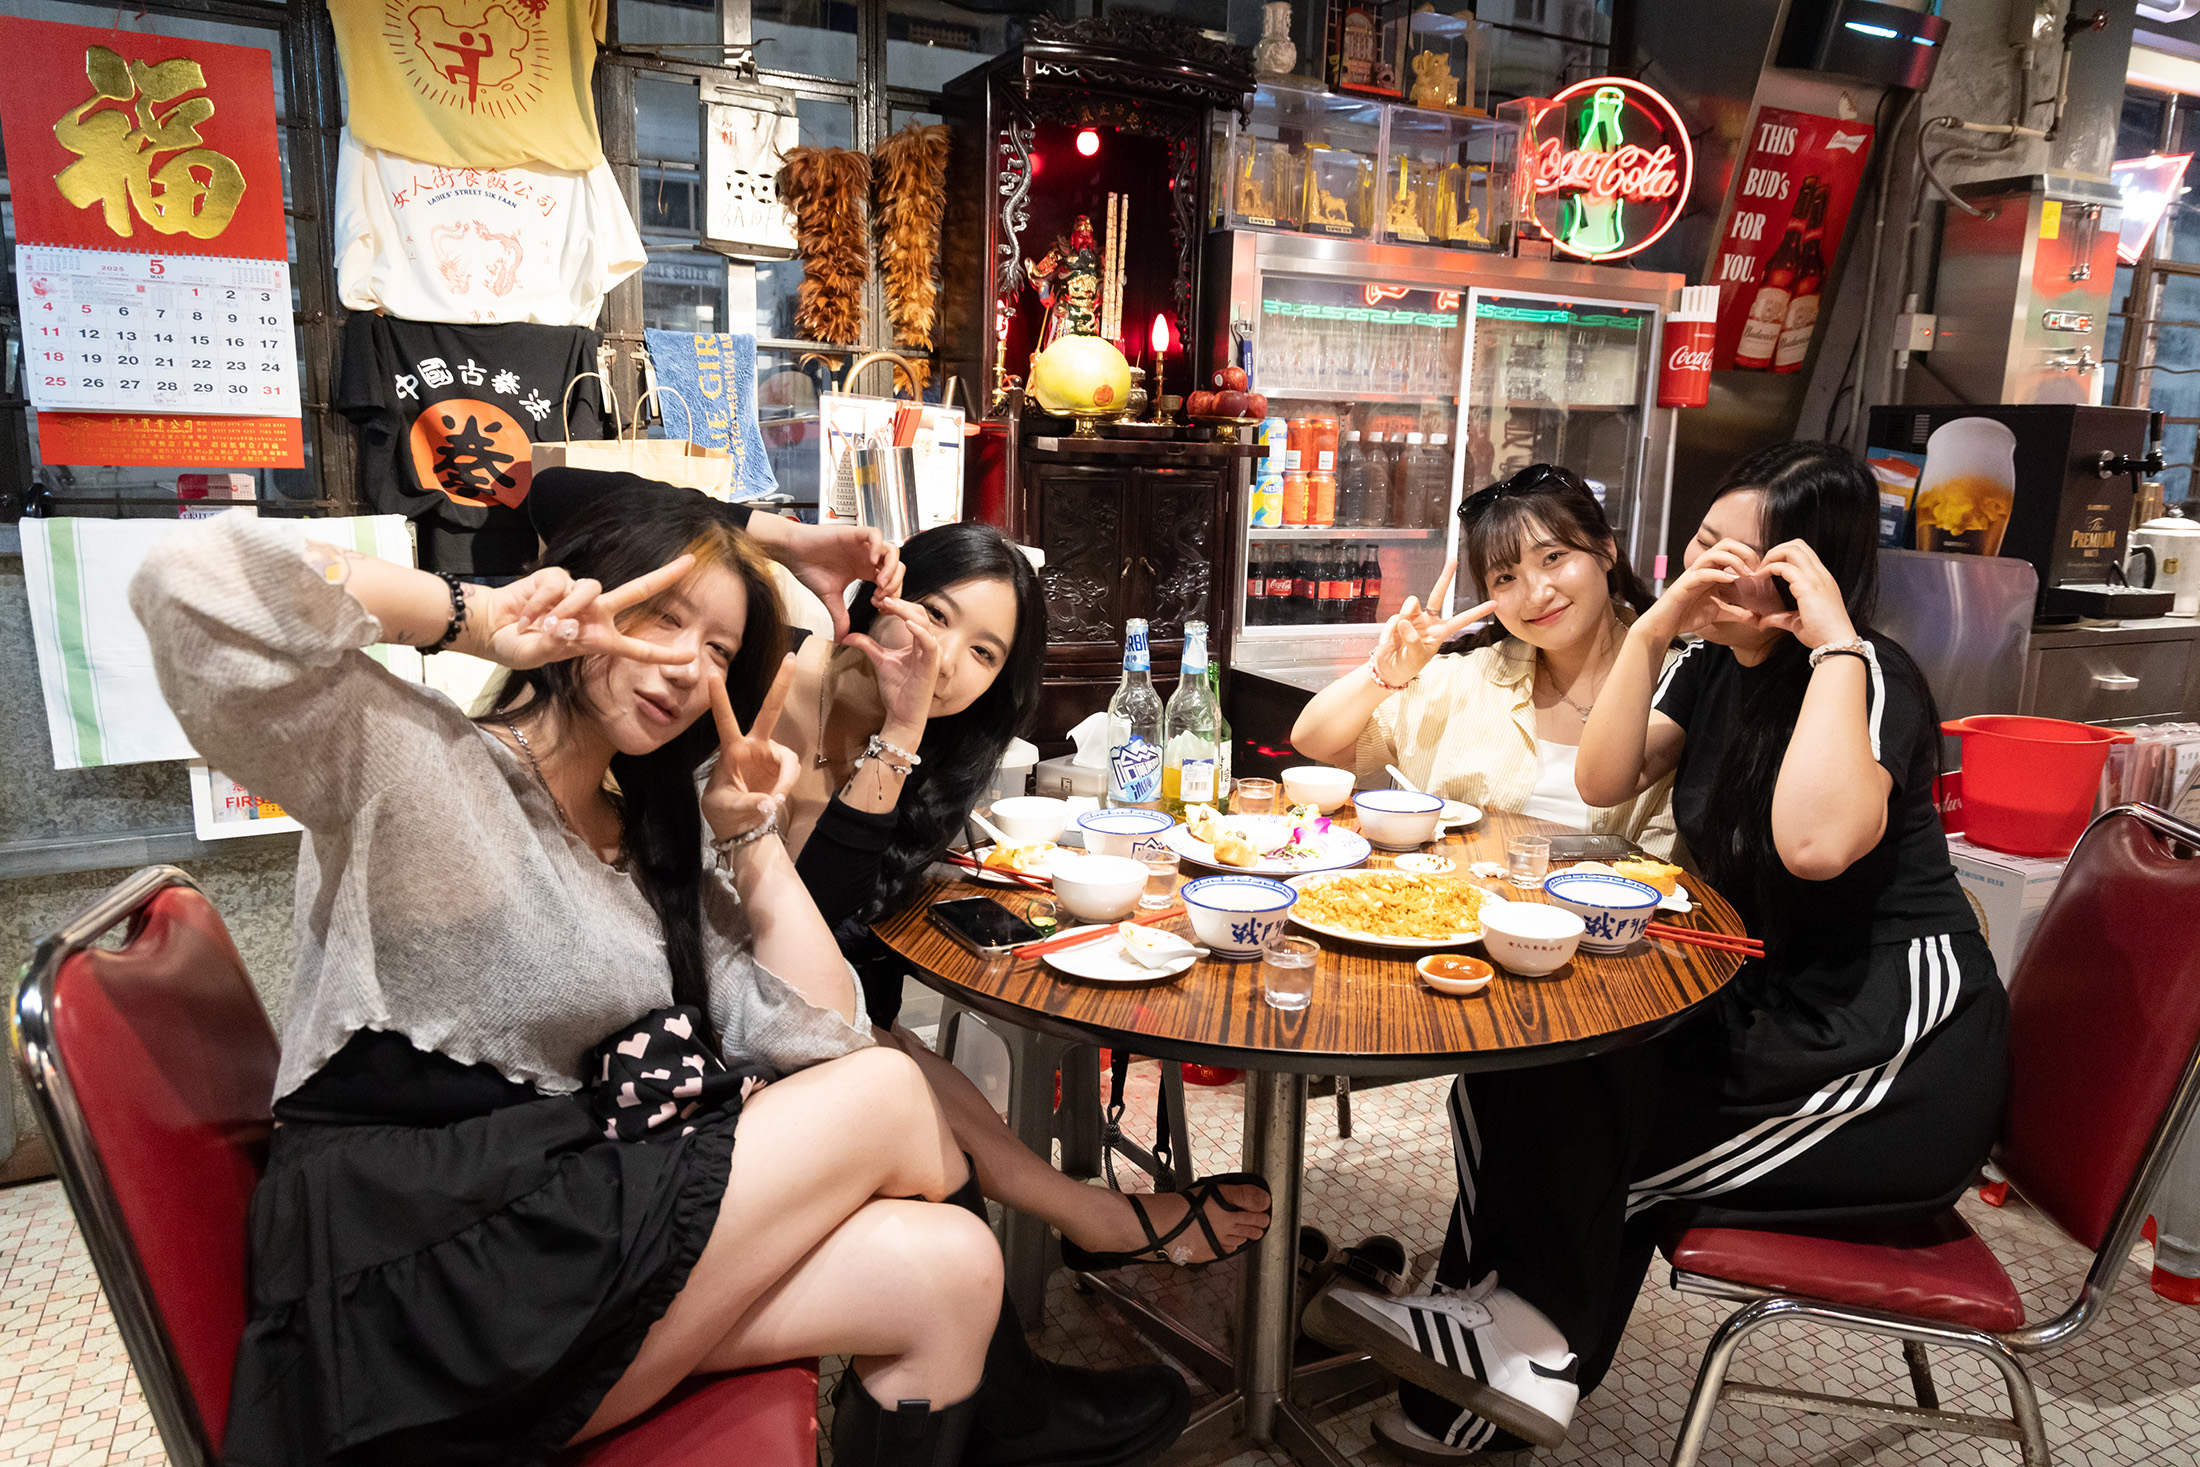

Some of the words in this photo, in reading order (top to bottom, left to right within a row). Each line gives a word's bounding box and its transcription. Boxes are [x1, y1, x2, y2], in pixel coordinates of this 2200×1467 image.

[53, 45, 247, 239] 福
[1757, 123, 1798, 156] THIS
[391, 165, 558, 218] 女人街食飯公司
[1742, 168, 1790, 201] BUD's
[426, 190, 453, 206] LADIES'
[454, 188, 483, 197] STREET
[484, 190, 497, 200] SIK
[1730, 211, 1766, 241] FOR
[149, 259, 165, 275] 5
[1720, 253, 1756, 284] YOU.
[191, 288, 199, 297] 1
[226, 290, 236, 299] 2
[261, 292, 270, 301] 3
[42, 302, 54, 311] 4
[81, 304, 92, 313] 5
[118, 307, 129, 316] 6
[156, 309, 165, 318] 7
[192, 312, 203, 321] 8
[228, 314, 238, 323] 9
[258, 316, 277, 325] 10
[41, 327, 60, 336] 11
[79, 329, 100, 339] 12
[117, 331, 137, 341] 13
[154, 333, 174, 343] 14
[191, 336, 210, 345] 15
[226, 338, 245, 347] 16
[260, 340, 278, 349] 17
[43, 352, 64, 361] 18
[81, 354, 102, 363] 19
[118, 355, 139, 365] 20
[155, 357, 174, 367] 21
[191, 359, 212, 369] 22
[226, 361, 247, 371] 23
[261, 363, 280, 372] 24
[694, 334, 723, 400] GIR
[45, 376, 66, 386] 25
[82, 378, 104, 388] 26
[120, 380, 140, 389] 27
[157, 381, 178, 391] 28
[193, 383, 213, 392] 29
[228, 384, 248, 394] 30
[262, 386, 280, 395] 31
[394, 357, 551, 422] 中國古拳法
[2070, 530, 2116, 548] PREMIUM
[225, 795, 271, 809] FIRS
